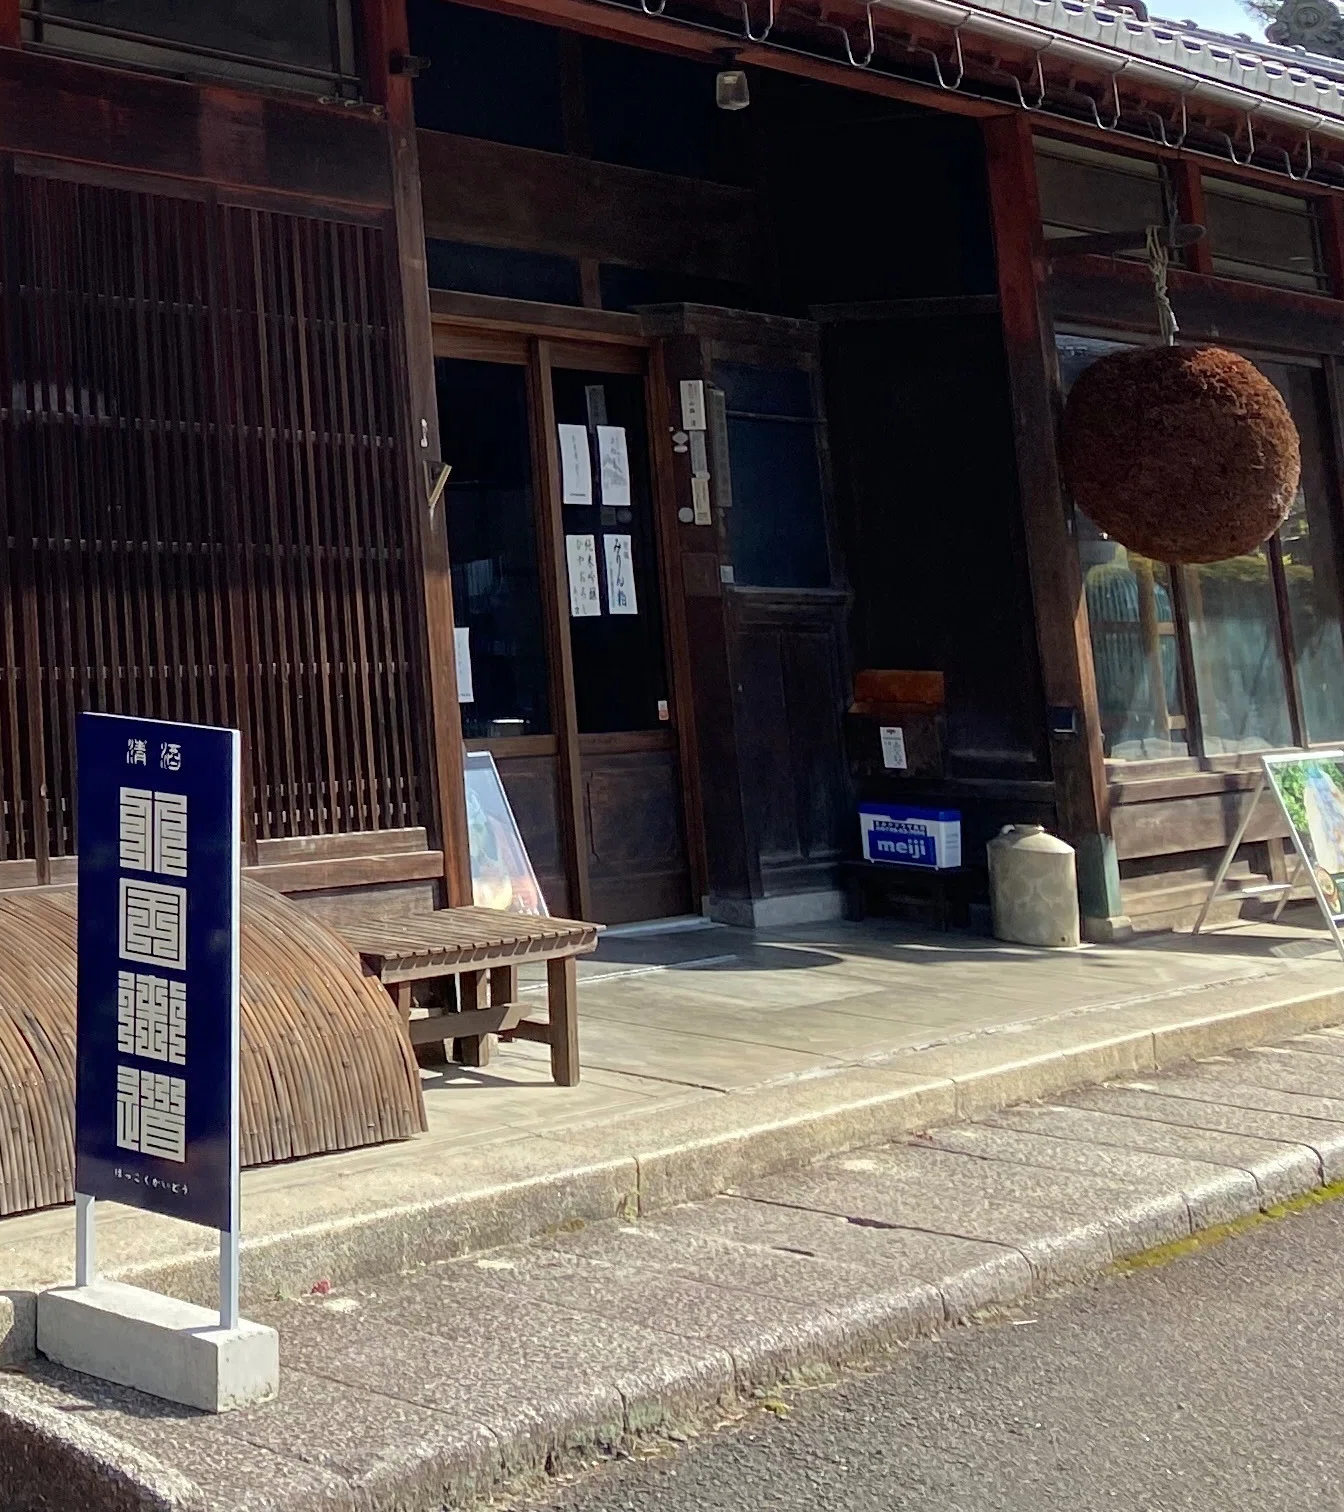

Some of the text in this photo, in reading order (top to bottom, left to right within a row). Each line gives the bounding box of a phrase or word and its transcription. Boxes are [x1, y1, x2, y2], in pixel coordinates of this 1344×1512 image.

[126, 738, 182, 771] 清酒
[877, 838, 926, 859] meiji
[114, 1167, 189, 1195] ほっこくかいどう
